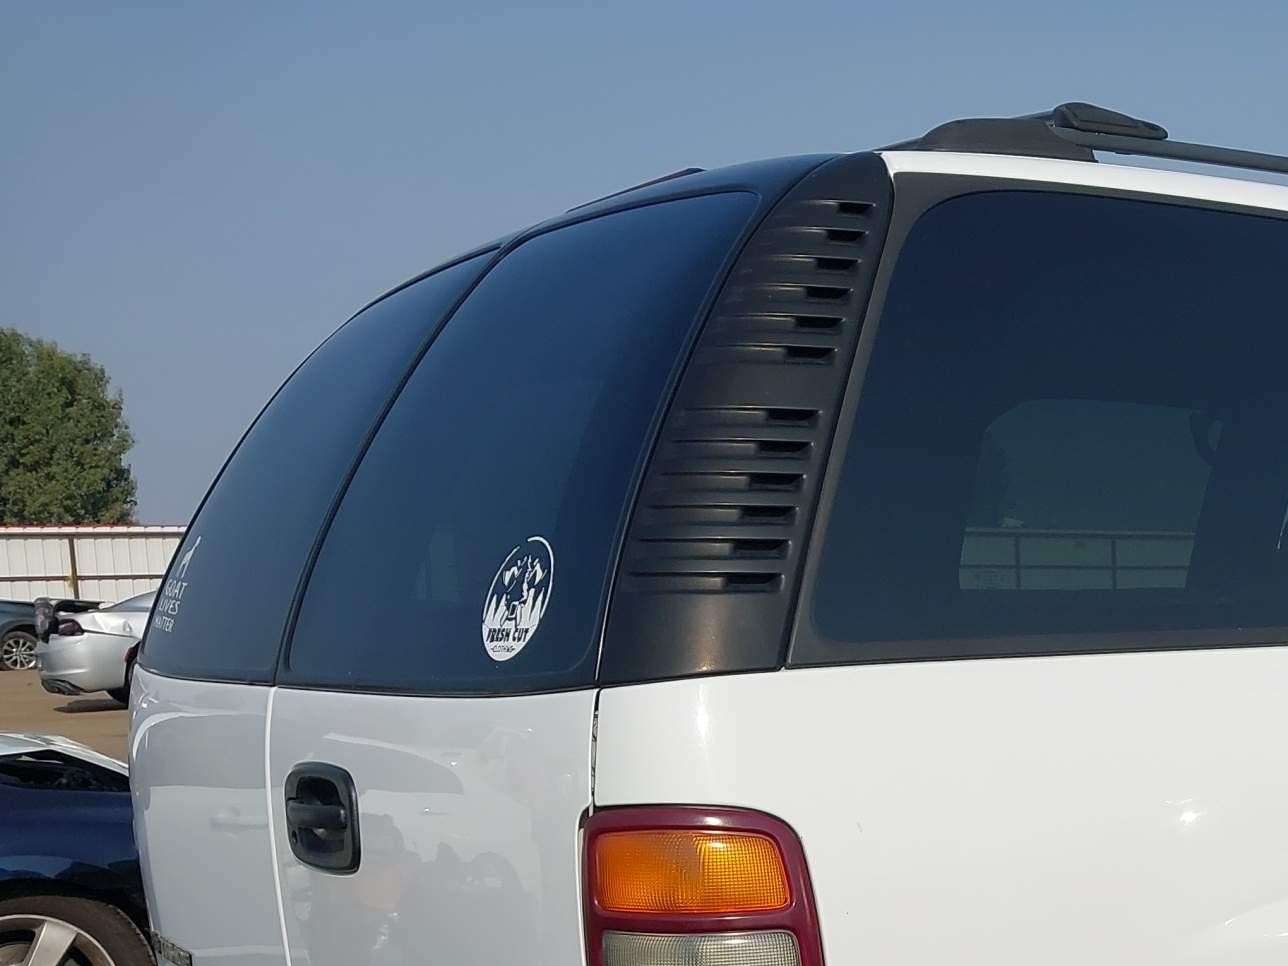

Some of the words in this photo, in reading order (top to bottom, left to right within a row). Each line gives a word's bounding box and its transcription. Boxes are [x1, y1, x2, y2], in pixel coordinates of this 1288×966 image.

[165, 579, 189, 599] GOAT
[159, 599, 181, 615] LIVES
[486, 627, 512, 643] FRESH
[512, 627, 530, 643] CUT
